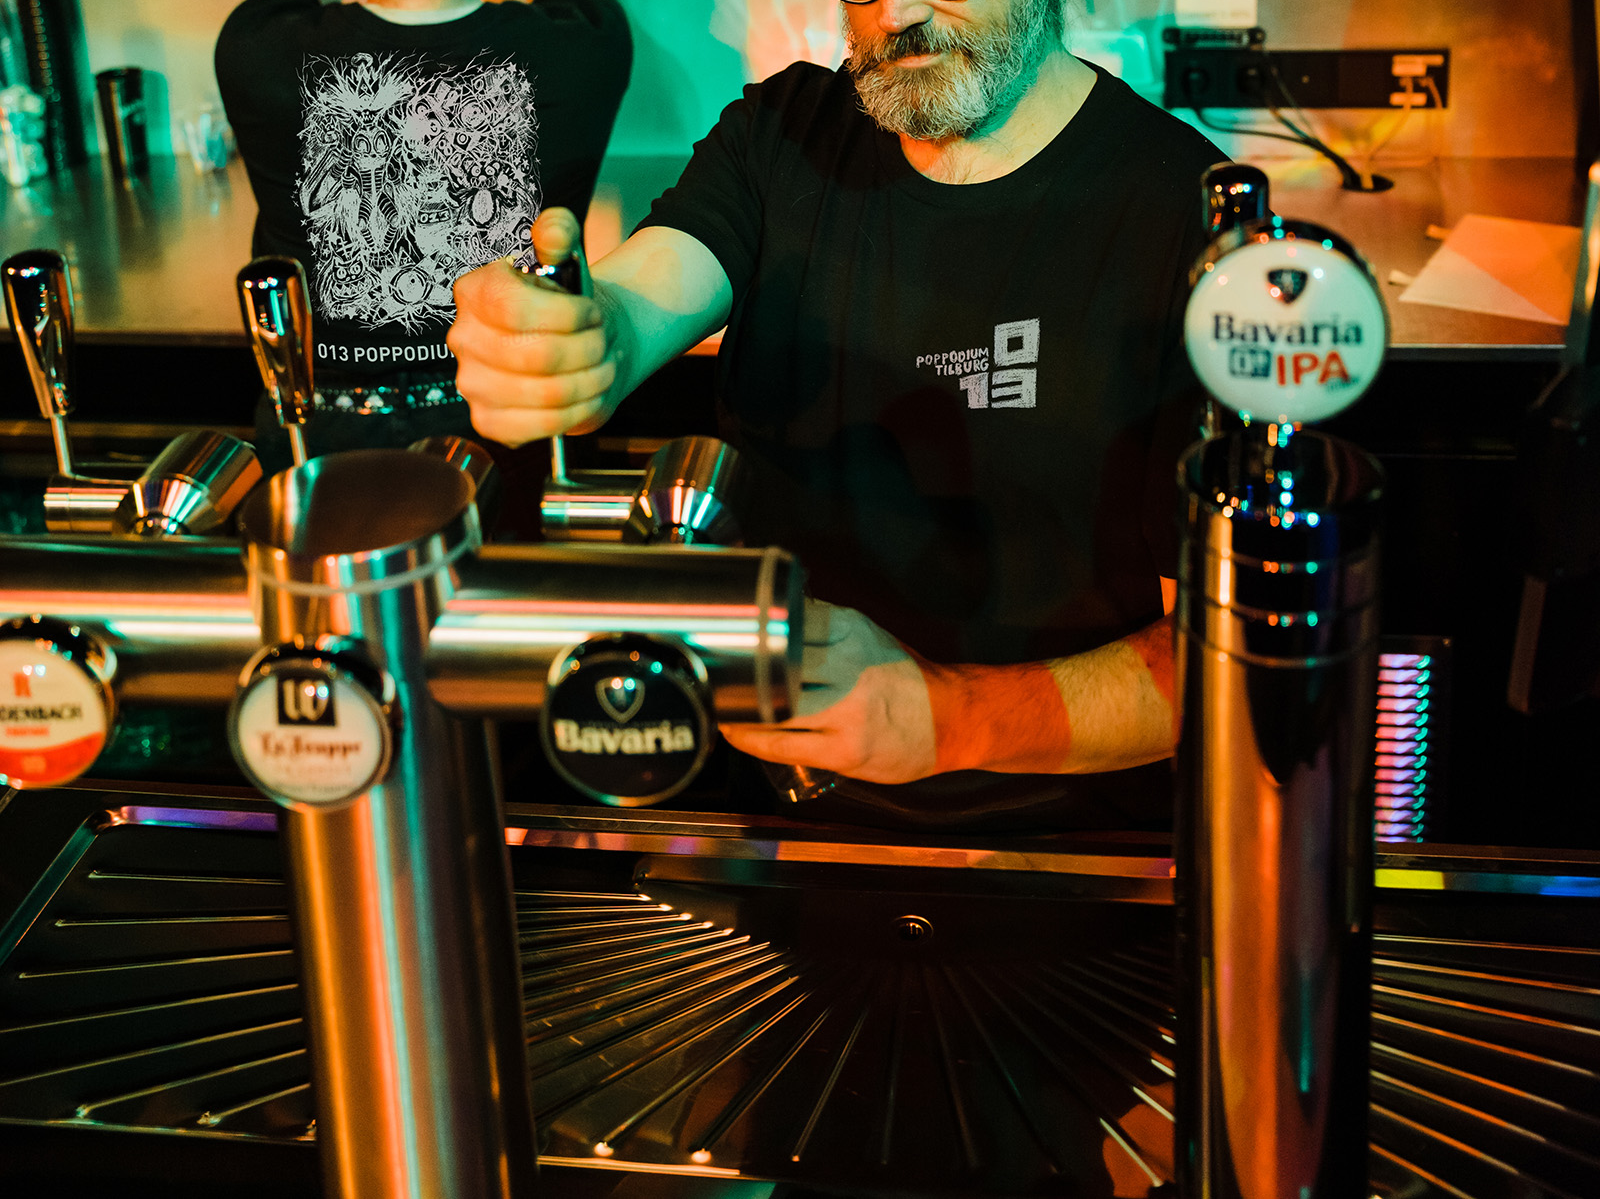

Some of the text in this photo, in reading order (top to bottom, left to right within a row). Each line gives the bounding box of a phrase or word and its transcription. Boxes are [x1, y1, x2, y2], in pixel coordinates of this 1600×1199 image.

[1212, 313, 1364, 345] Bavaria
[317, 343, 455, 363] 013 POPPODIU
[916, 347, 989, 369] POPPODIUM
[935, 357, 990, 377] TILBURG
[1276, 351, 1351, 385] IPA
[553, 719, 696, 755] Bavaria
